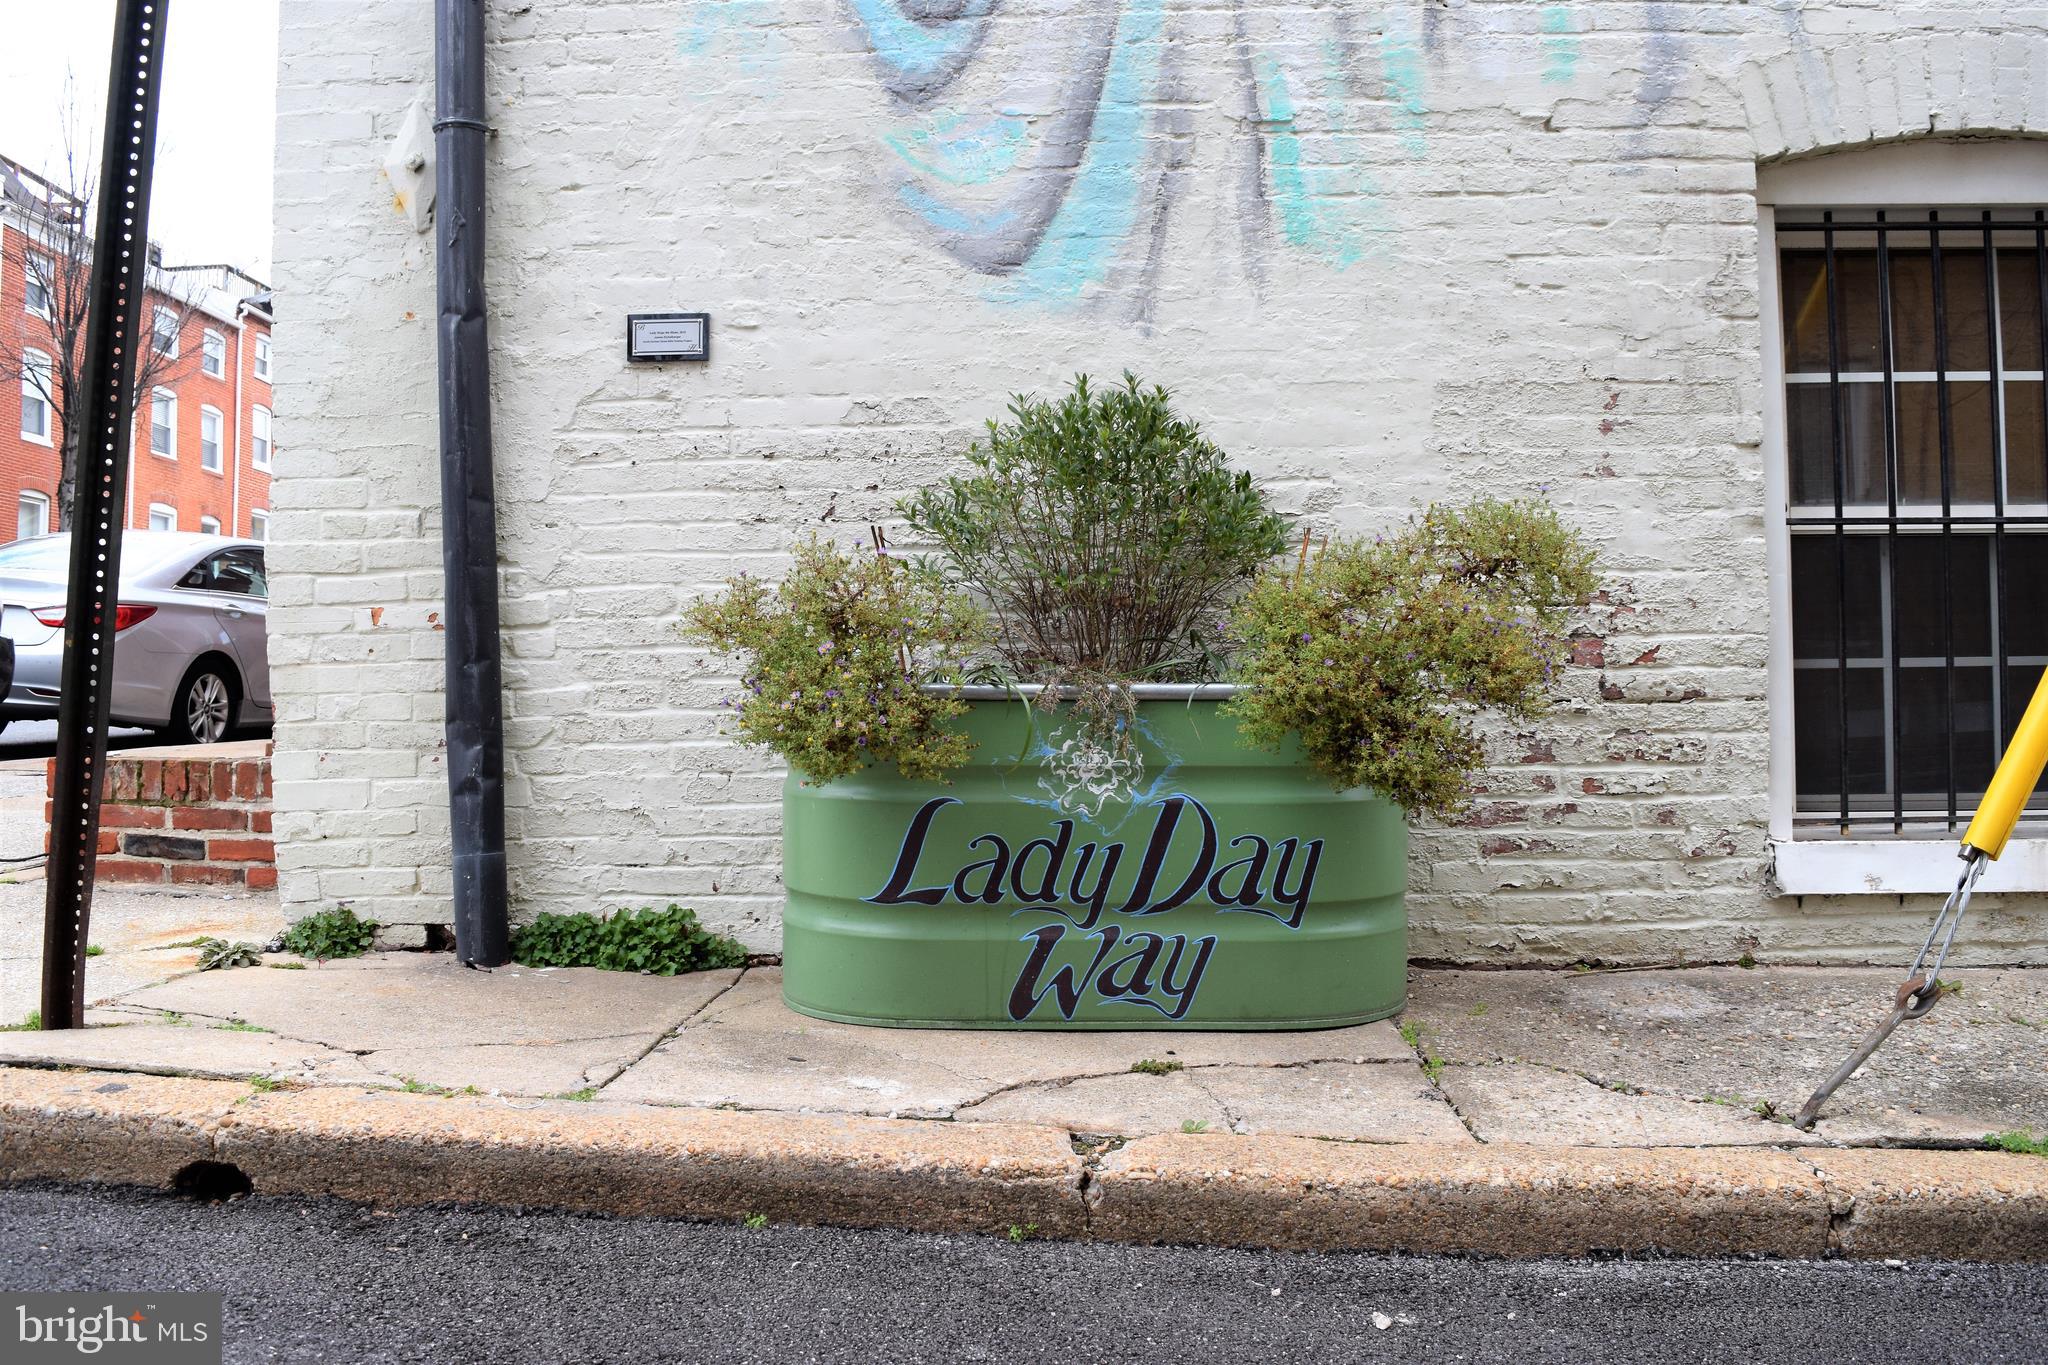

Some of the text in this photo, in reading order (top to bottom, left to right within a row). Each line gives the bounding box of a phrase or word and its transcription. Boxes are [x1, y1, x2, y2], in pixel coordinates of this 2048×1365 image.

[860, 792, 1325, 931] Lady Day
[1007, 923, 1218, 1022] Way
